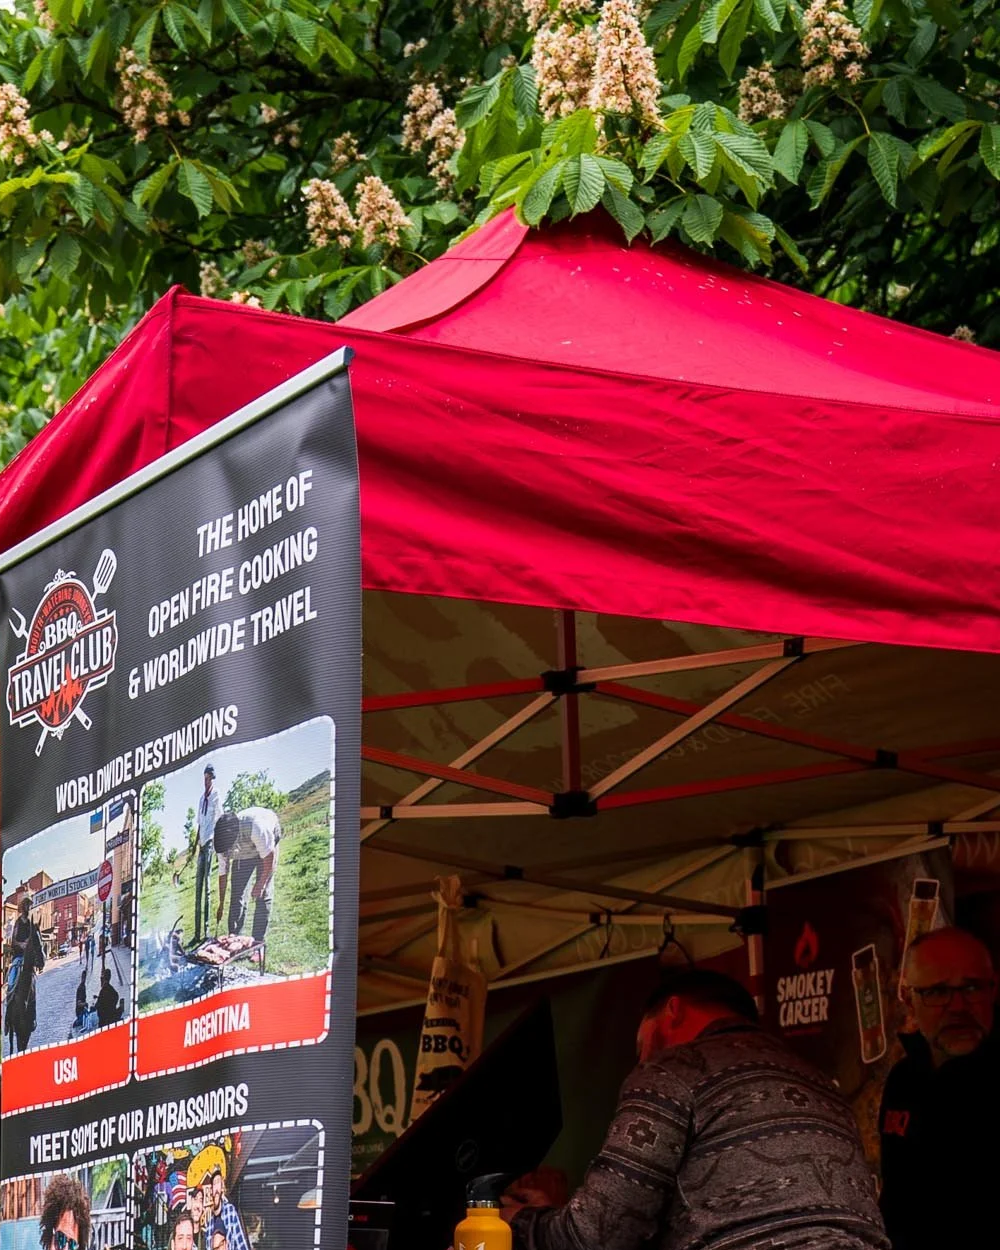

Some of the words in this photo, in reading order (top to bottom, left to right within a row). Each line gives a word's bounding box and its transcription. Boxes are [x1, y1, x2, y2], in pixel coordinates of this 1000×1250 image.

[197, 513, 233, 558] THE
[237, 484, 282, 542] HOME
[286, 470, 313, 511] OF
[148, 587, 189, 638] OPEN
[192, 567, 234, 615] FIRE
[238, 527, 318, 595] COOKING
[12, 651, 67, 711] TRAVEL
[71, 626, 112, 680] CLUB
[44, 611, 78, 650] BBQ
[128, 667, 141, 700] &
[143, 617, 246, 693] WORLDWIDE
[250, 586, 317, 646] TRAVEL
[56, 751, 132, 813] WORLDWIDE
[134, 704, 238, 777] DESTINATIONS
[184, 1002, 250, 1048] ARGENTINA
[777, 968, 835, 1003] SMOKEY
[780, 996, 829, 1027] CARTER
[53, 1057, 79, 1085] USA
[352, 1037, 407, 1138] BQ
[422, 1035, 466, 1062] BBQ
[30, 1130, 70, 1165] MEET
[71, 1121, 98, 1158] SOME
[100, 1116, 116, 1149] OF
[118, 1110, 144, 1145] OUR
[146, 1083, 249, 1138] AMBASSADORS
